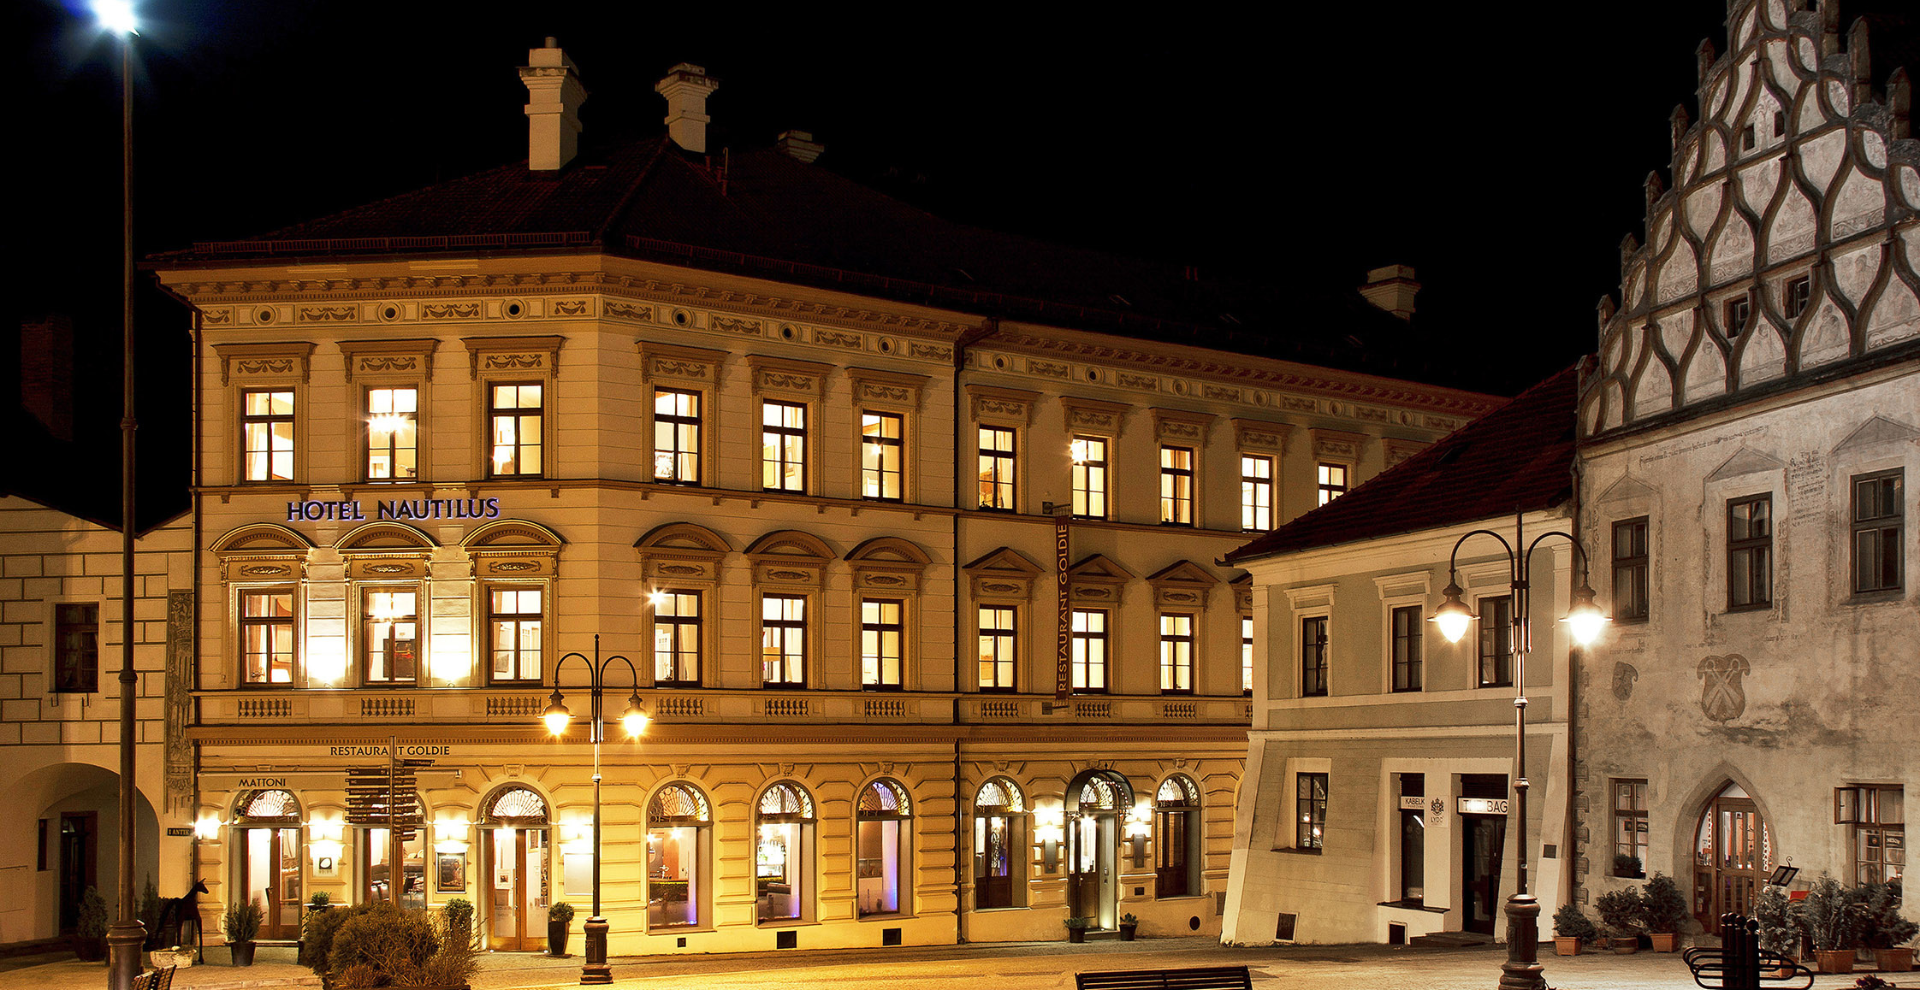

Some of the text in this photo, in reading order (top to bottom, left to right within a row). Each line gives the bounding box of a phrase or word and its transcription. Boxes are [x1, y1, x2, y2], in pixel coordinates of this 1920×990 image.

[286, 498, 500, 521] HOTEL NAUTILUS
[1057, 524, 1068, 691] RESTAURANT GOLDIE
[407, 746, 450, 756] GOLDIE
[238, 778, 286, 787] MATTONI
